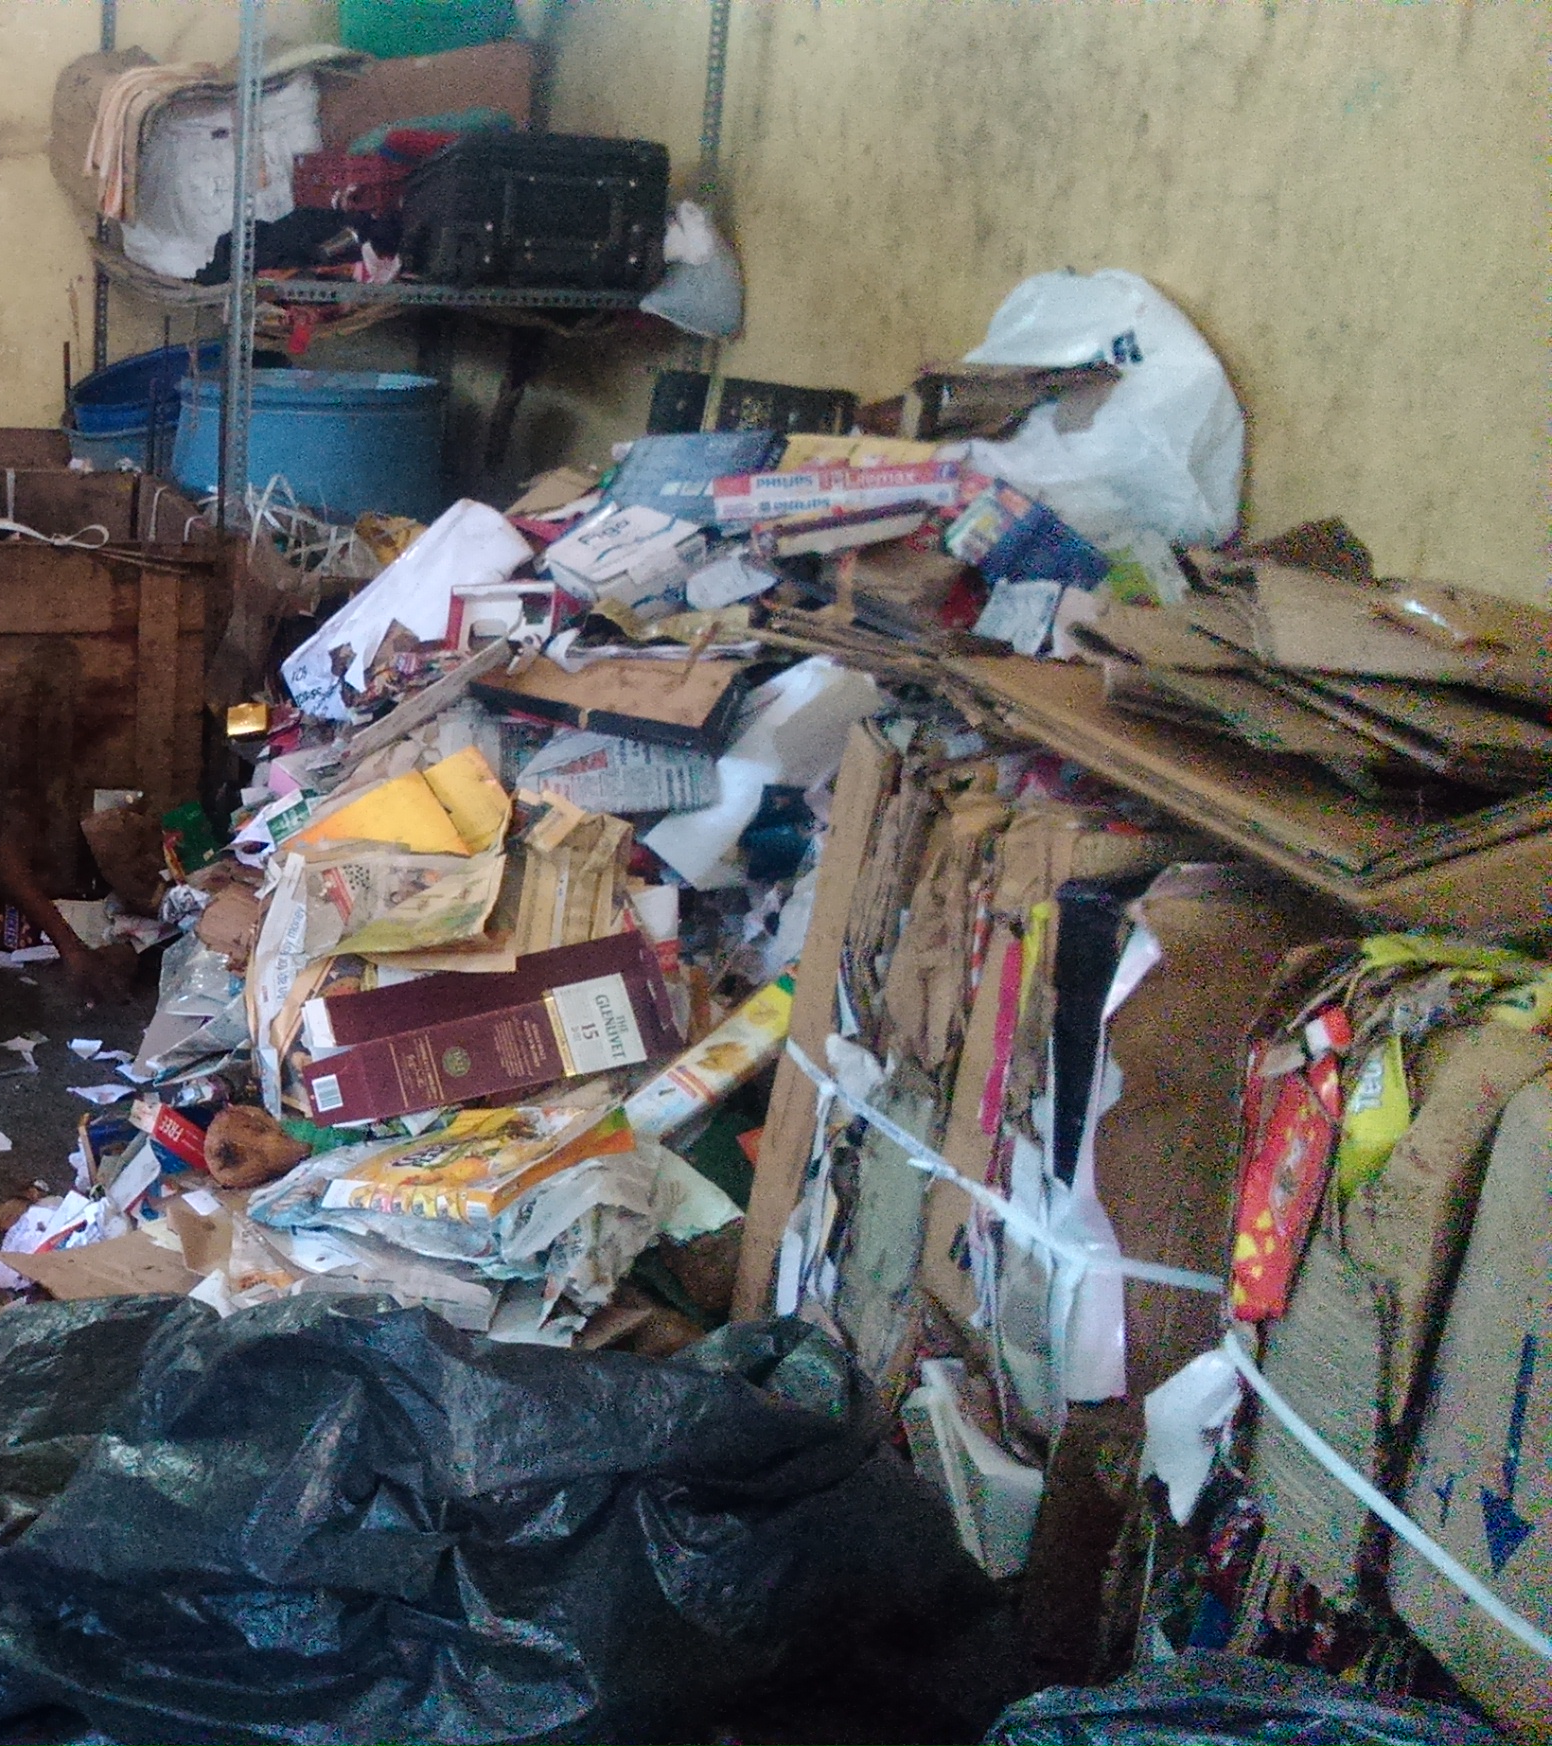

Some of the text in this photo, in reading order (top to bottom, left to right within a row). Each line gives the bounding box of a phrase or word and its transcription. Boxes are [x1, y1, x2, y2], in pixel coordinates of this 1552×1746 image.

[580, 1021, 600, 1041] 15
[595, 994, 627, 1060] GLENLIVET
[616, 1015, 630, 1033] THE
[158, 1115, 185, 1142] FREE
